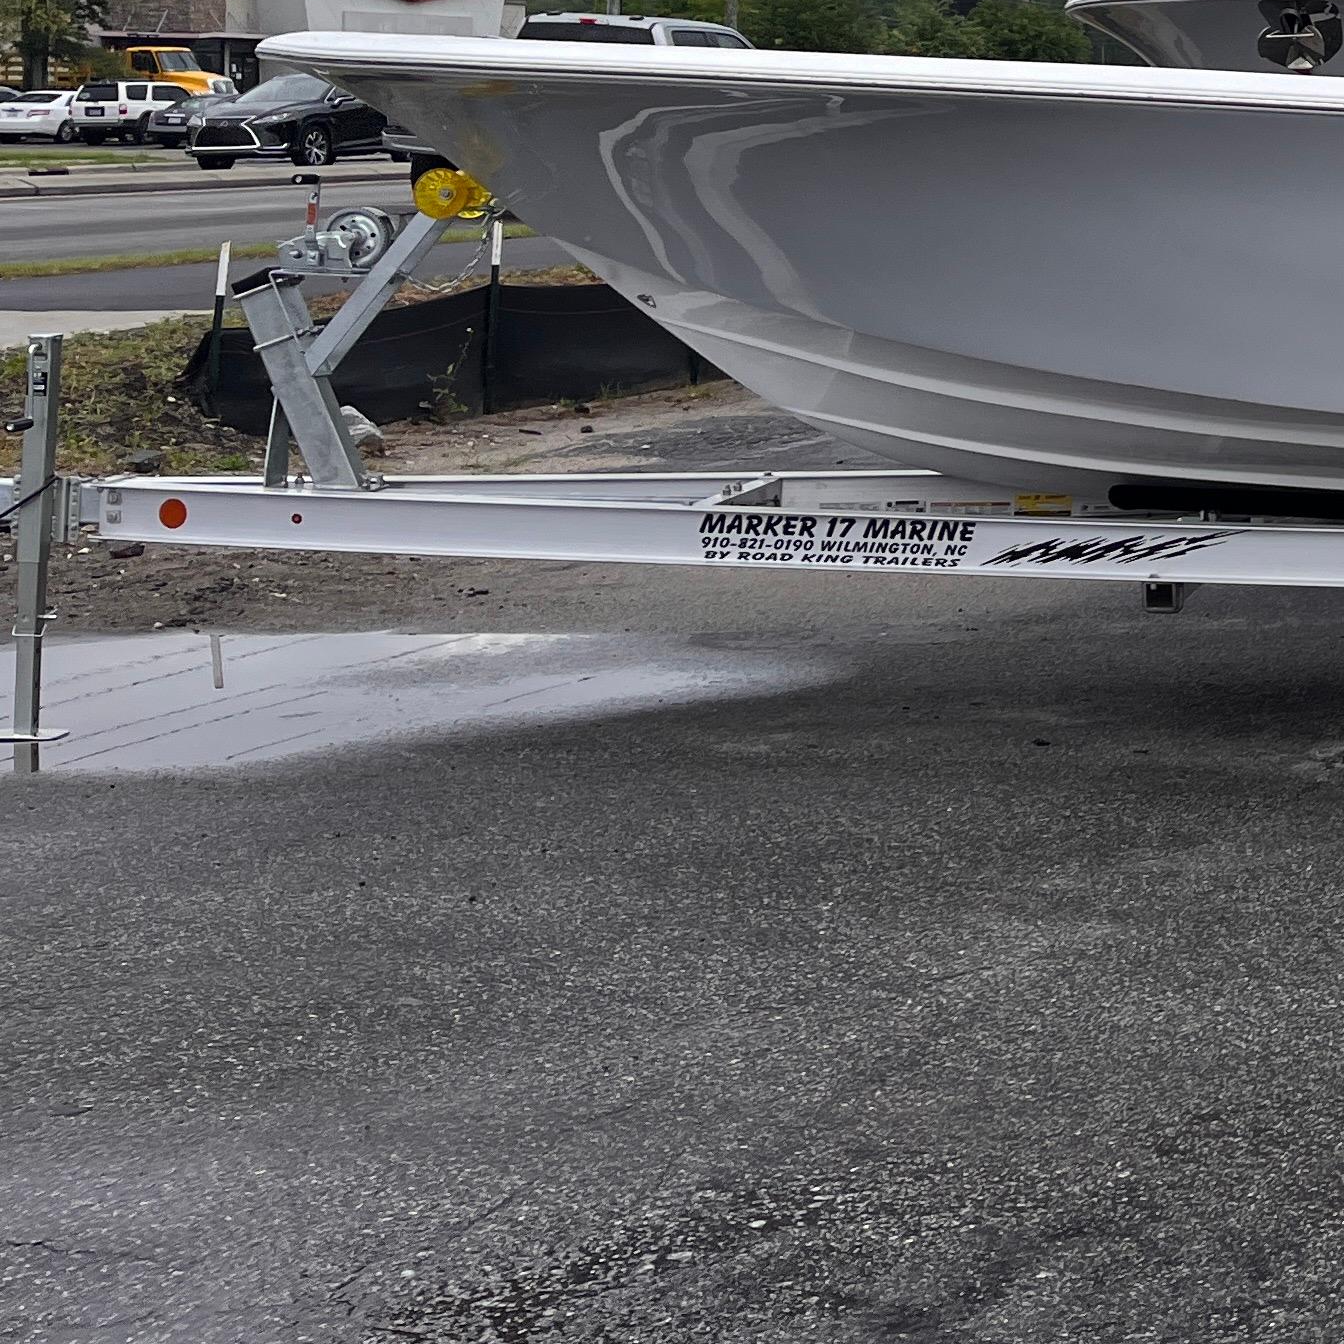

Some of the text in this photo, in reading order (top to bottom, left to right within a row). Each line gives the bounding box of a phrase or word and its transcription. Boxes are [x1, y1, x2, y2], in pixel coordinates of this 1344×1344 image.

[699, 513, 977, 542] MARKER 17 MARINE
[701, 536, 968, 556] 910-821-0190 WILMINGTON, NC
[704, 550, 961, 567] BY ROAD KING TRAILERS
